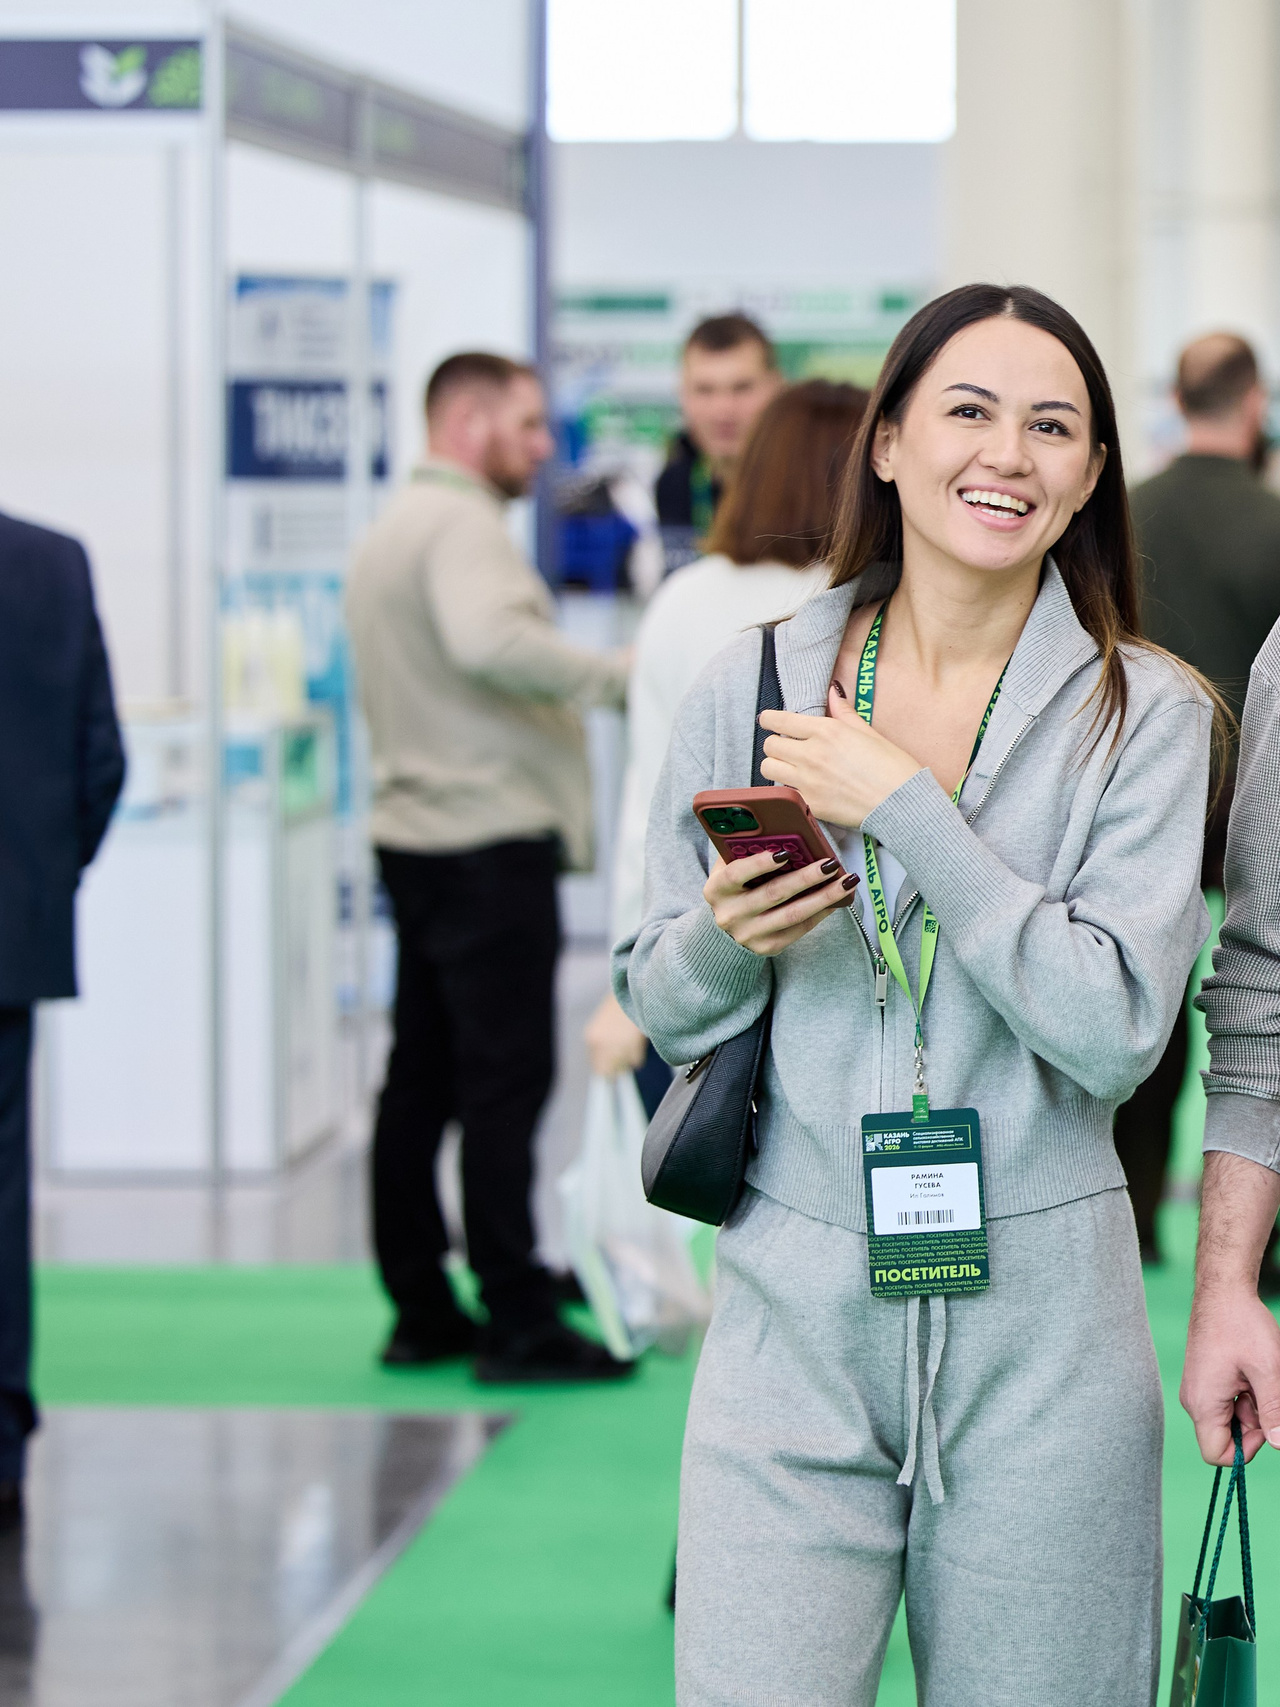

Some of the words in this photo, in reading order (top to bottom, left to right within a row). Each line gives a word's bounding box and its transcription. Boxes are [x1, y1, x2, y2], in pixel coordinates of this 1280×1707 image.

[859, 628, 879, 695] КАЗАНЬ
[857, 698, 872, 725] АГ
[864, 833, 876, 884] ЗАНЬ
[871, 889, 888, 933] АГРО
[875, 1264, 981, 1283] ПОСЕТИТЕЛЬ
